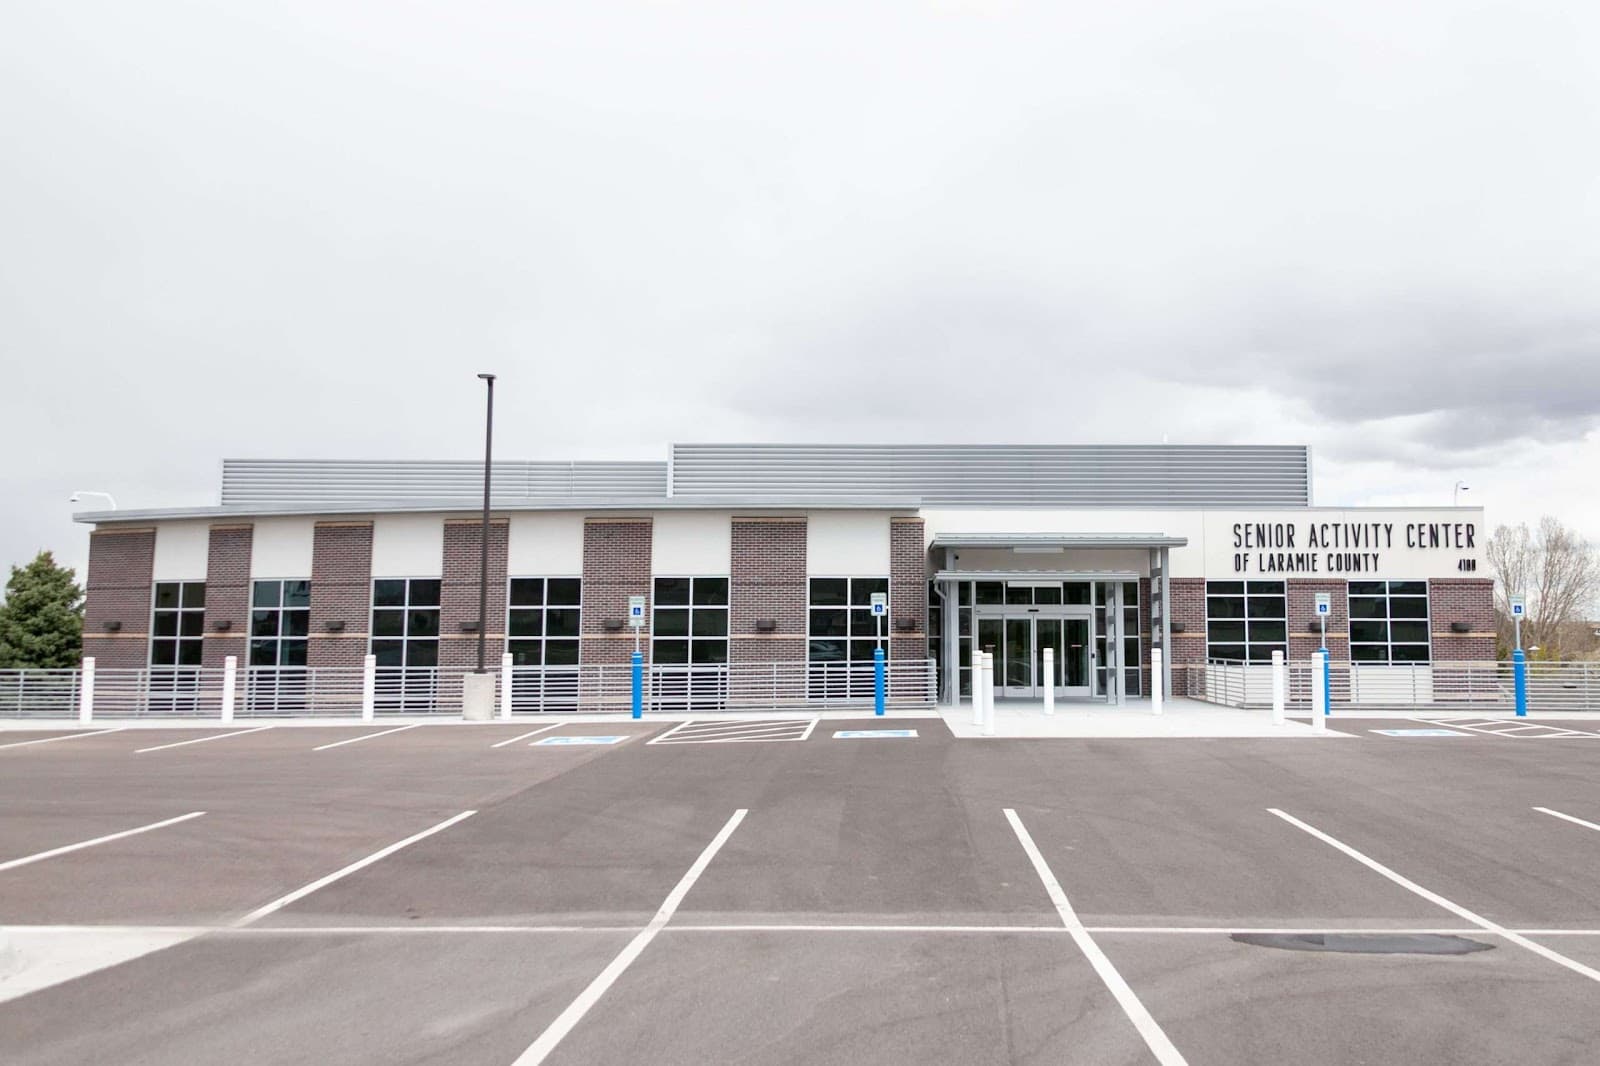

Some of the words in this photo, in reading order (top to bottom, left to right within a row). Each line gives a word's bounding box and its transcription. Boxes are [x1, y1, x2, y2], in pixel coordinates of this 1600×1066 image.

[1233, 523, 1295, 548] SENIOR
[1308, 523, 1393, 549] ACTIVITY
[1406, 523, 1475, 549] CENTER
[1234, 552, 1250, 572] OF
[1259, 552, 1318, 572] LARAMIE
[1327, 552, 1380, 572] COUNTY
